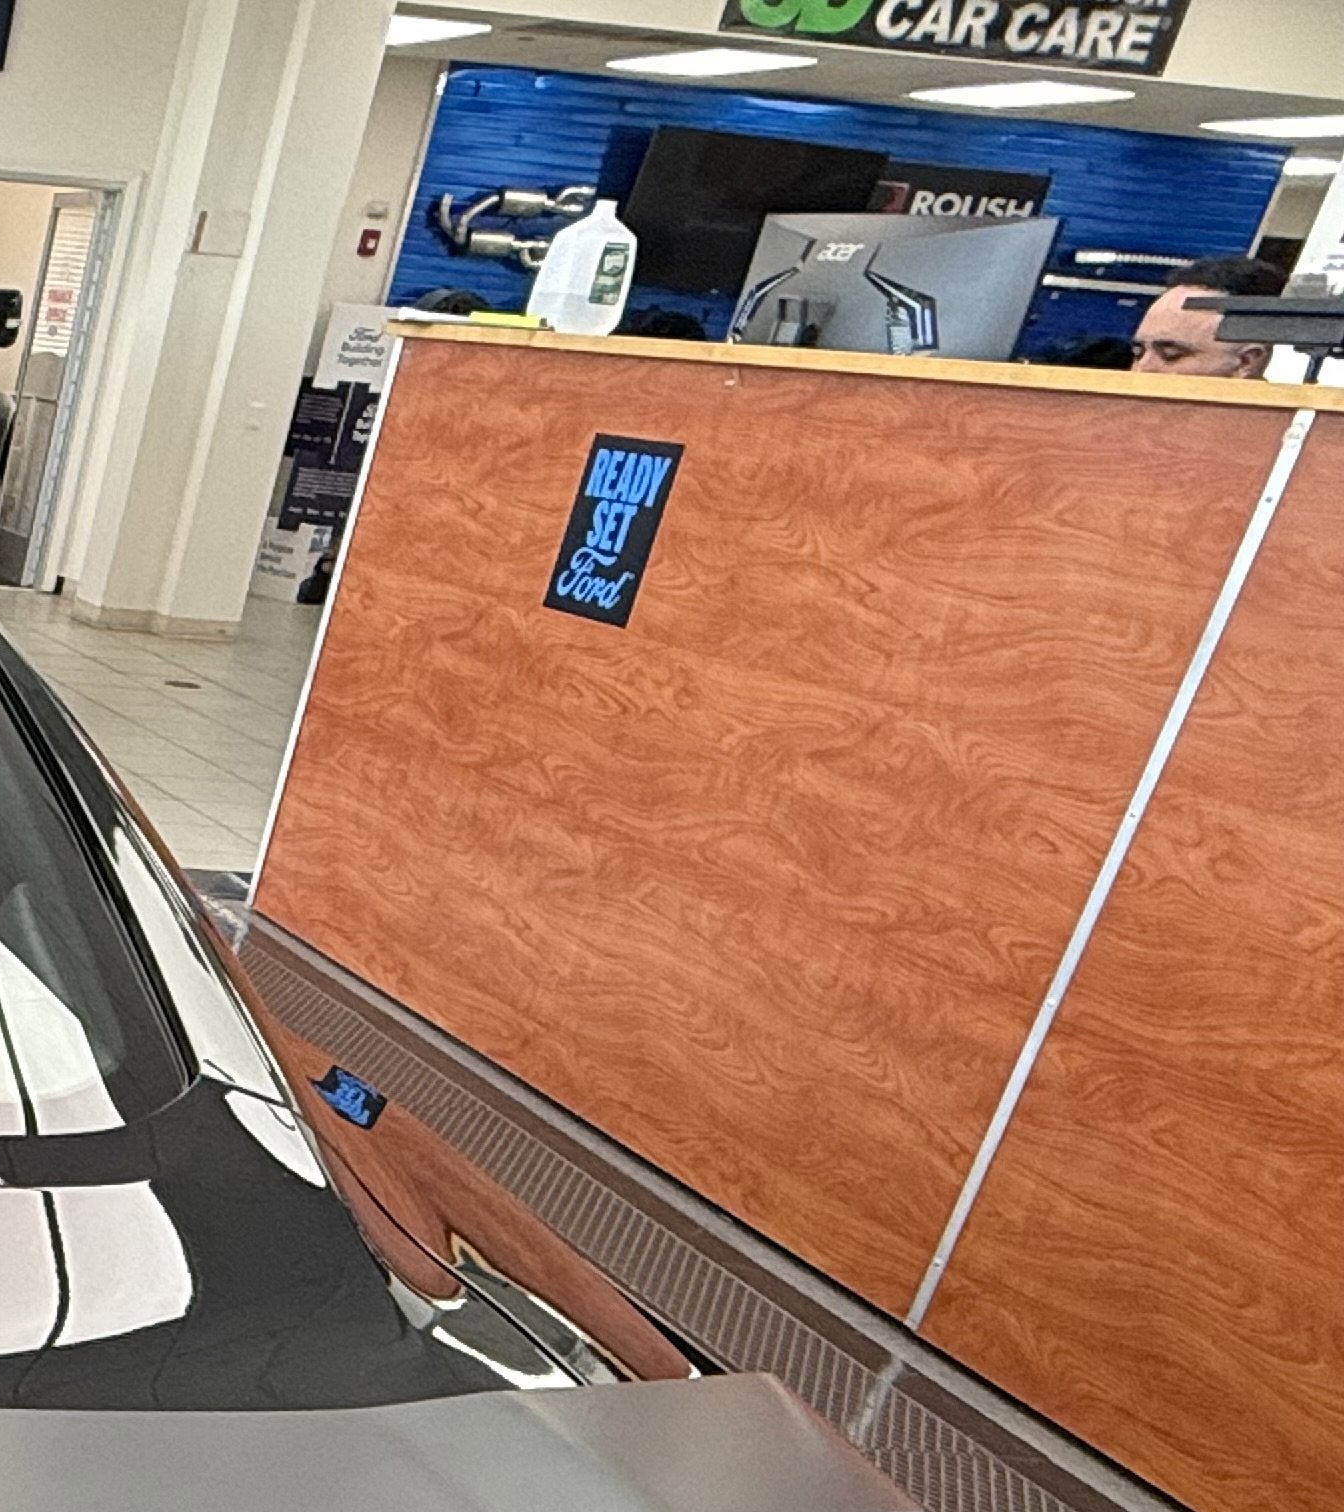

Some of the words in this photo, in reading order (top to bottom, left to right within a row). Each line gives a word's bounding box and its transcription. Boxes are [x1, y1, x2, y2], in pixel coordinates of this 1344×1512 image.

[875, 0, 999, 48] CAR
[1005, 6, 1160, 64] CARE
[909, 190, 1034, 218] ROUSH
[817, 242, 864, 262] acer
[584, 448, 673, 508] READY
[586, 500, 638, 554] SET
[556, 546, 635, 610] Ford
